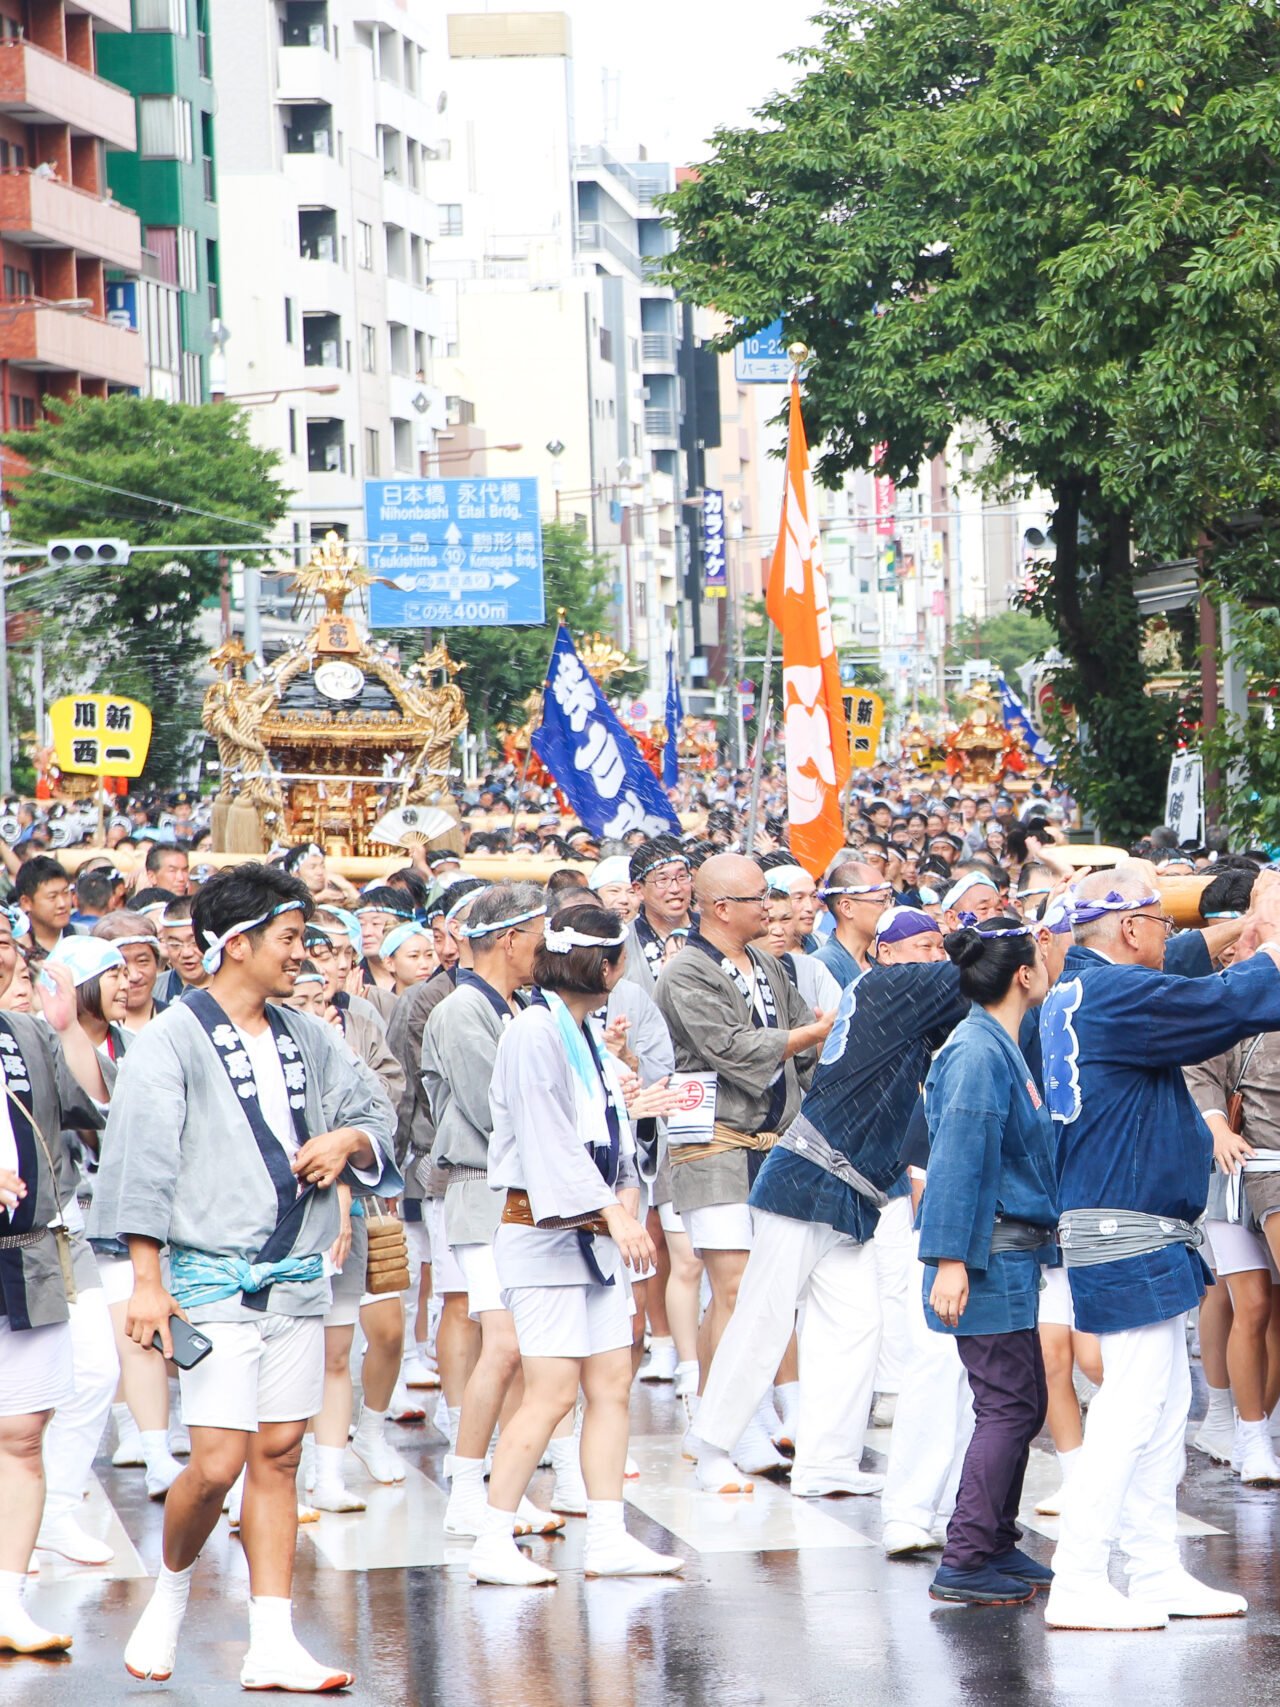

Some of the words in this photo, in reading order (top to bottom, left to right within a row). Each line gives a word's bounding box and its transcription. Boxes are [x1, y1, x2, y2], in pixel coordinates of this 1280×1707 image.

[743, 363, 797, 375] パーキン
[383, 484, 446, 505] 日本橋
[457, 483, 521, 504] 永代橋
[380, 506, 449, 520] Nihonbashi
[458, 505, 486, 519] Eitai
[489, 504, 522, 520] Brdg.
[704, 492, 726, 576] カラオケ
[379, 532, 430, 553] 月島
[472, 532, 536, 553] 駒形橋
[372, 554, 437, 568] Tsukishima
[447, 552, 461, 563] 10
[470, 553, 513, 569] Komagata
